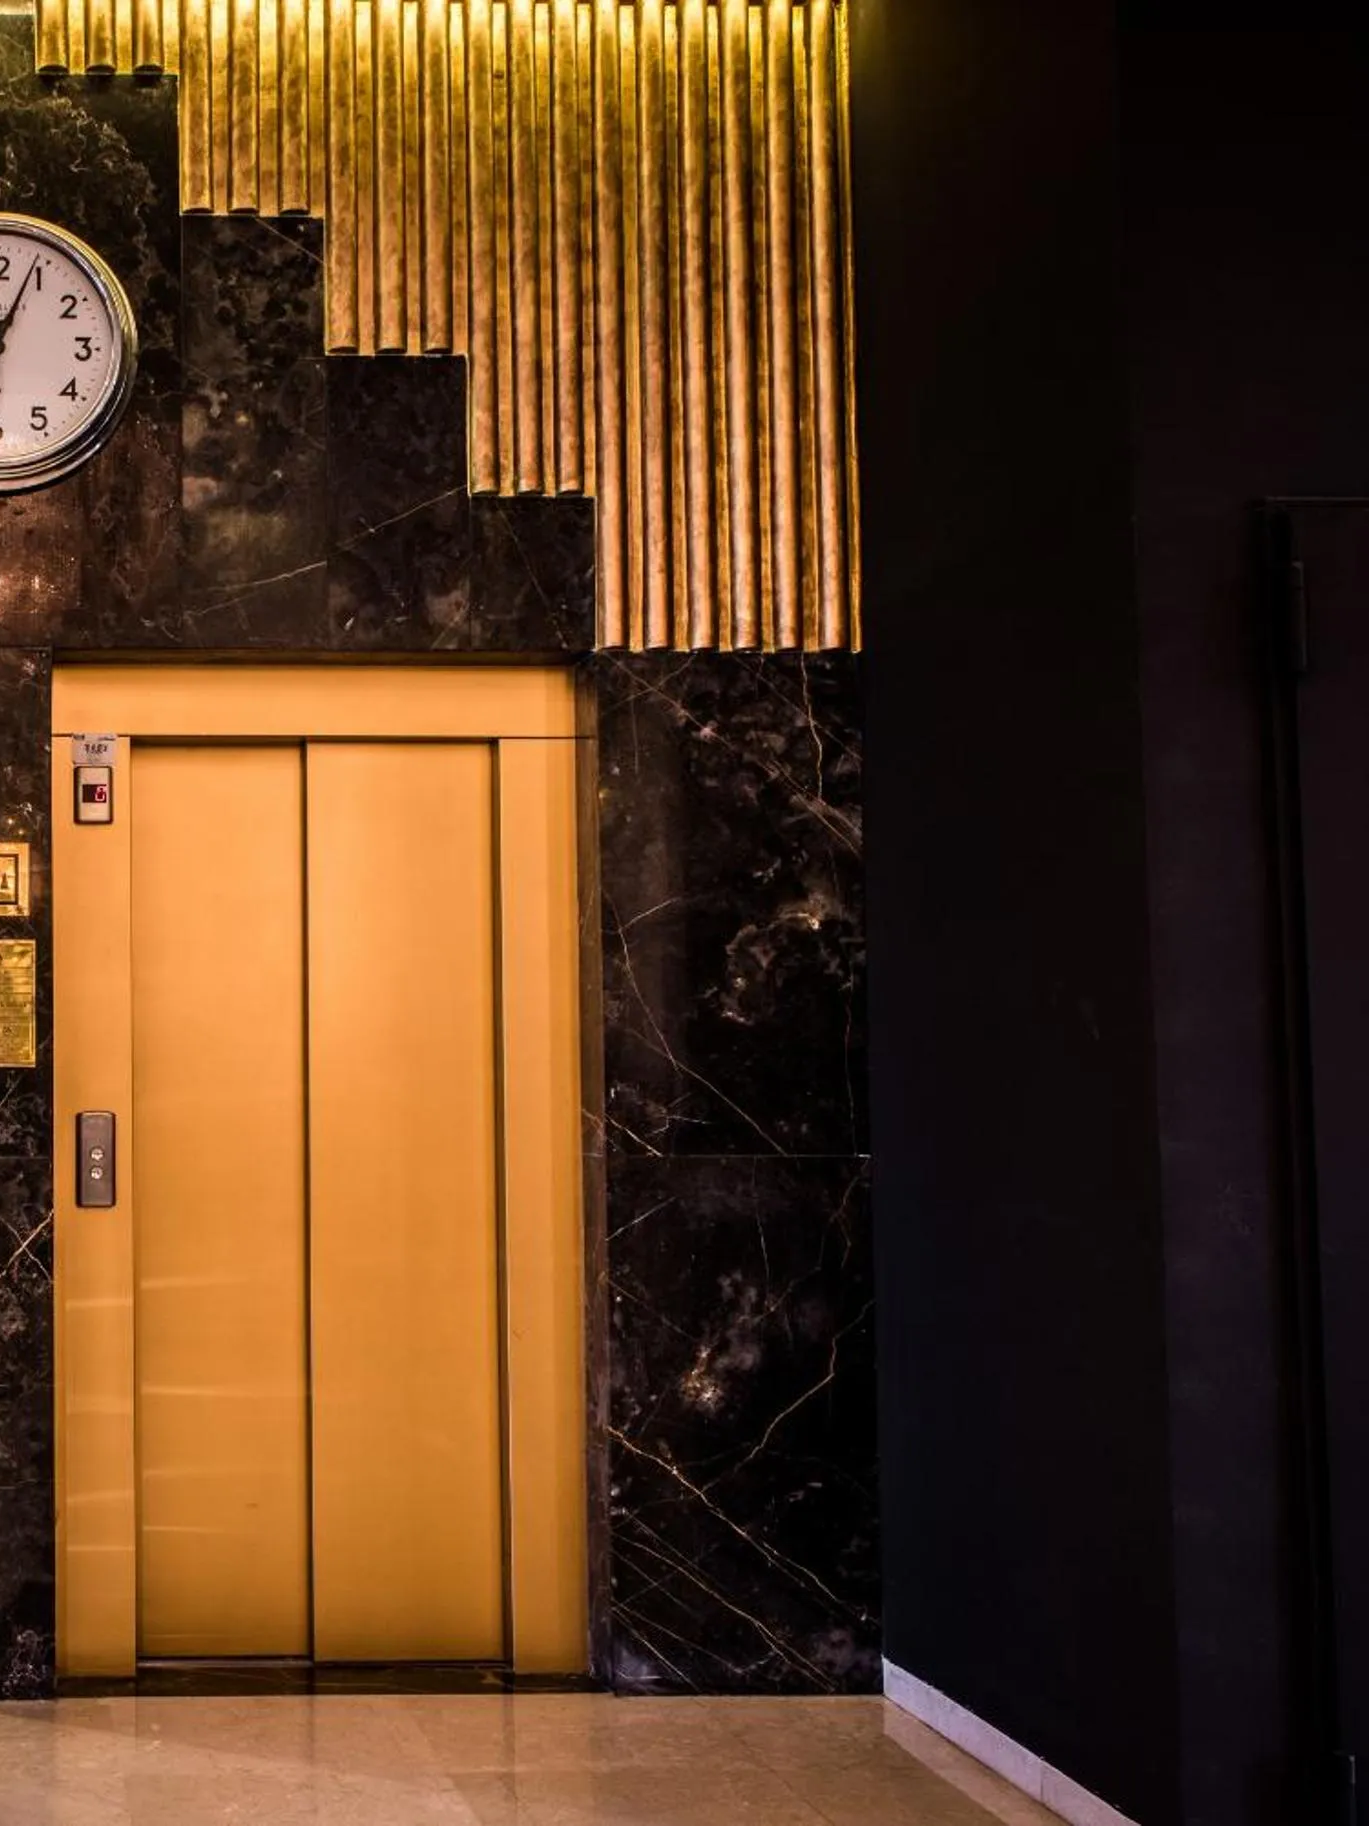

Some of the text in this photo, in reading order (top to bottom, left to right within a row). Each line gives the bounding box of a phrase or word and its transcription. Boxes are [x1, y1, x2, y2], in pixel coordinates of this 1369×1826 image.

[34, 266, 43, 291] 1
[59, 294, 78, 319] 2
[74, 336, 92, 362] 3
[58, 377, 79, 401] 4
[30, 406, 48, 431] 5
